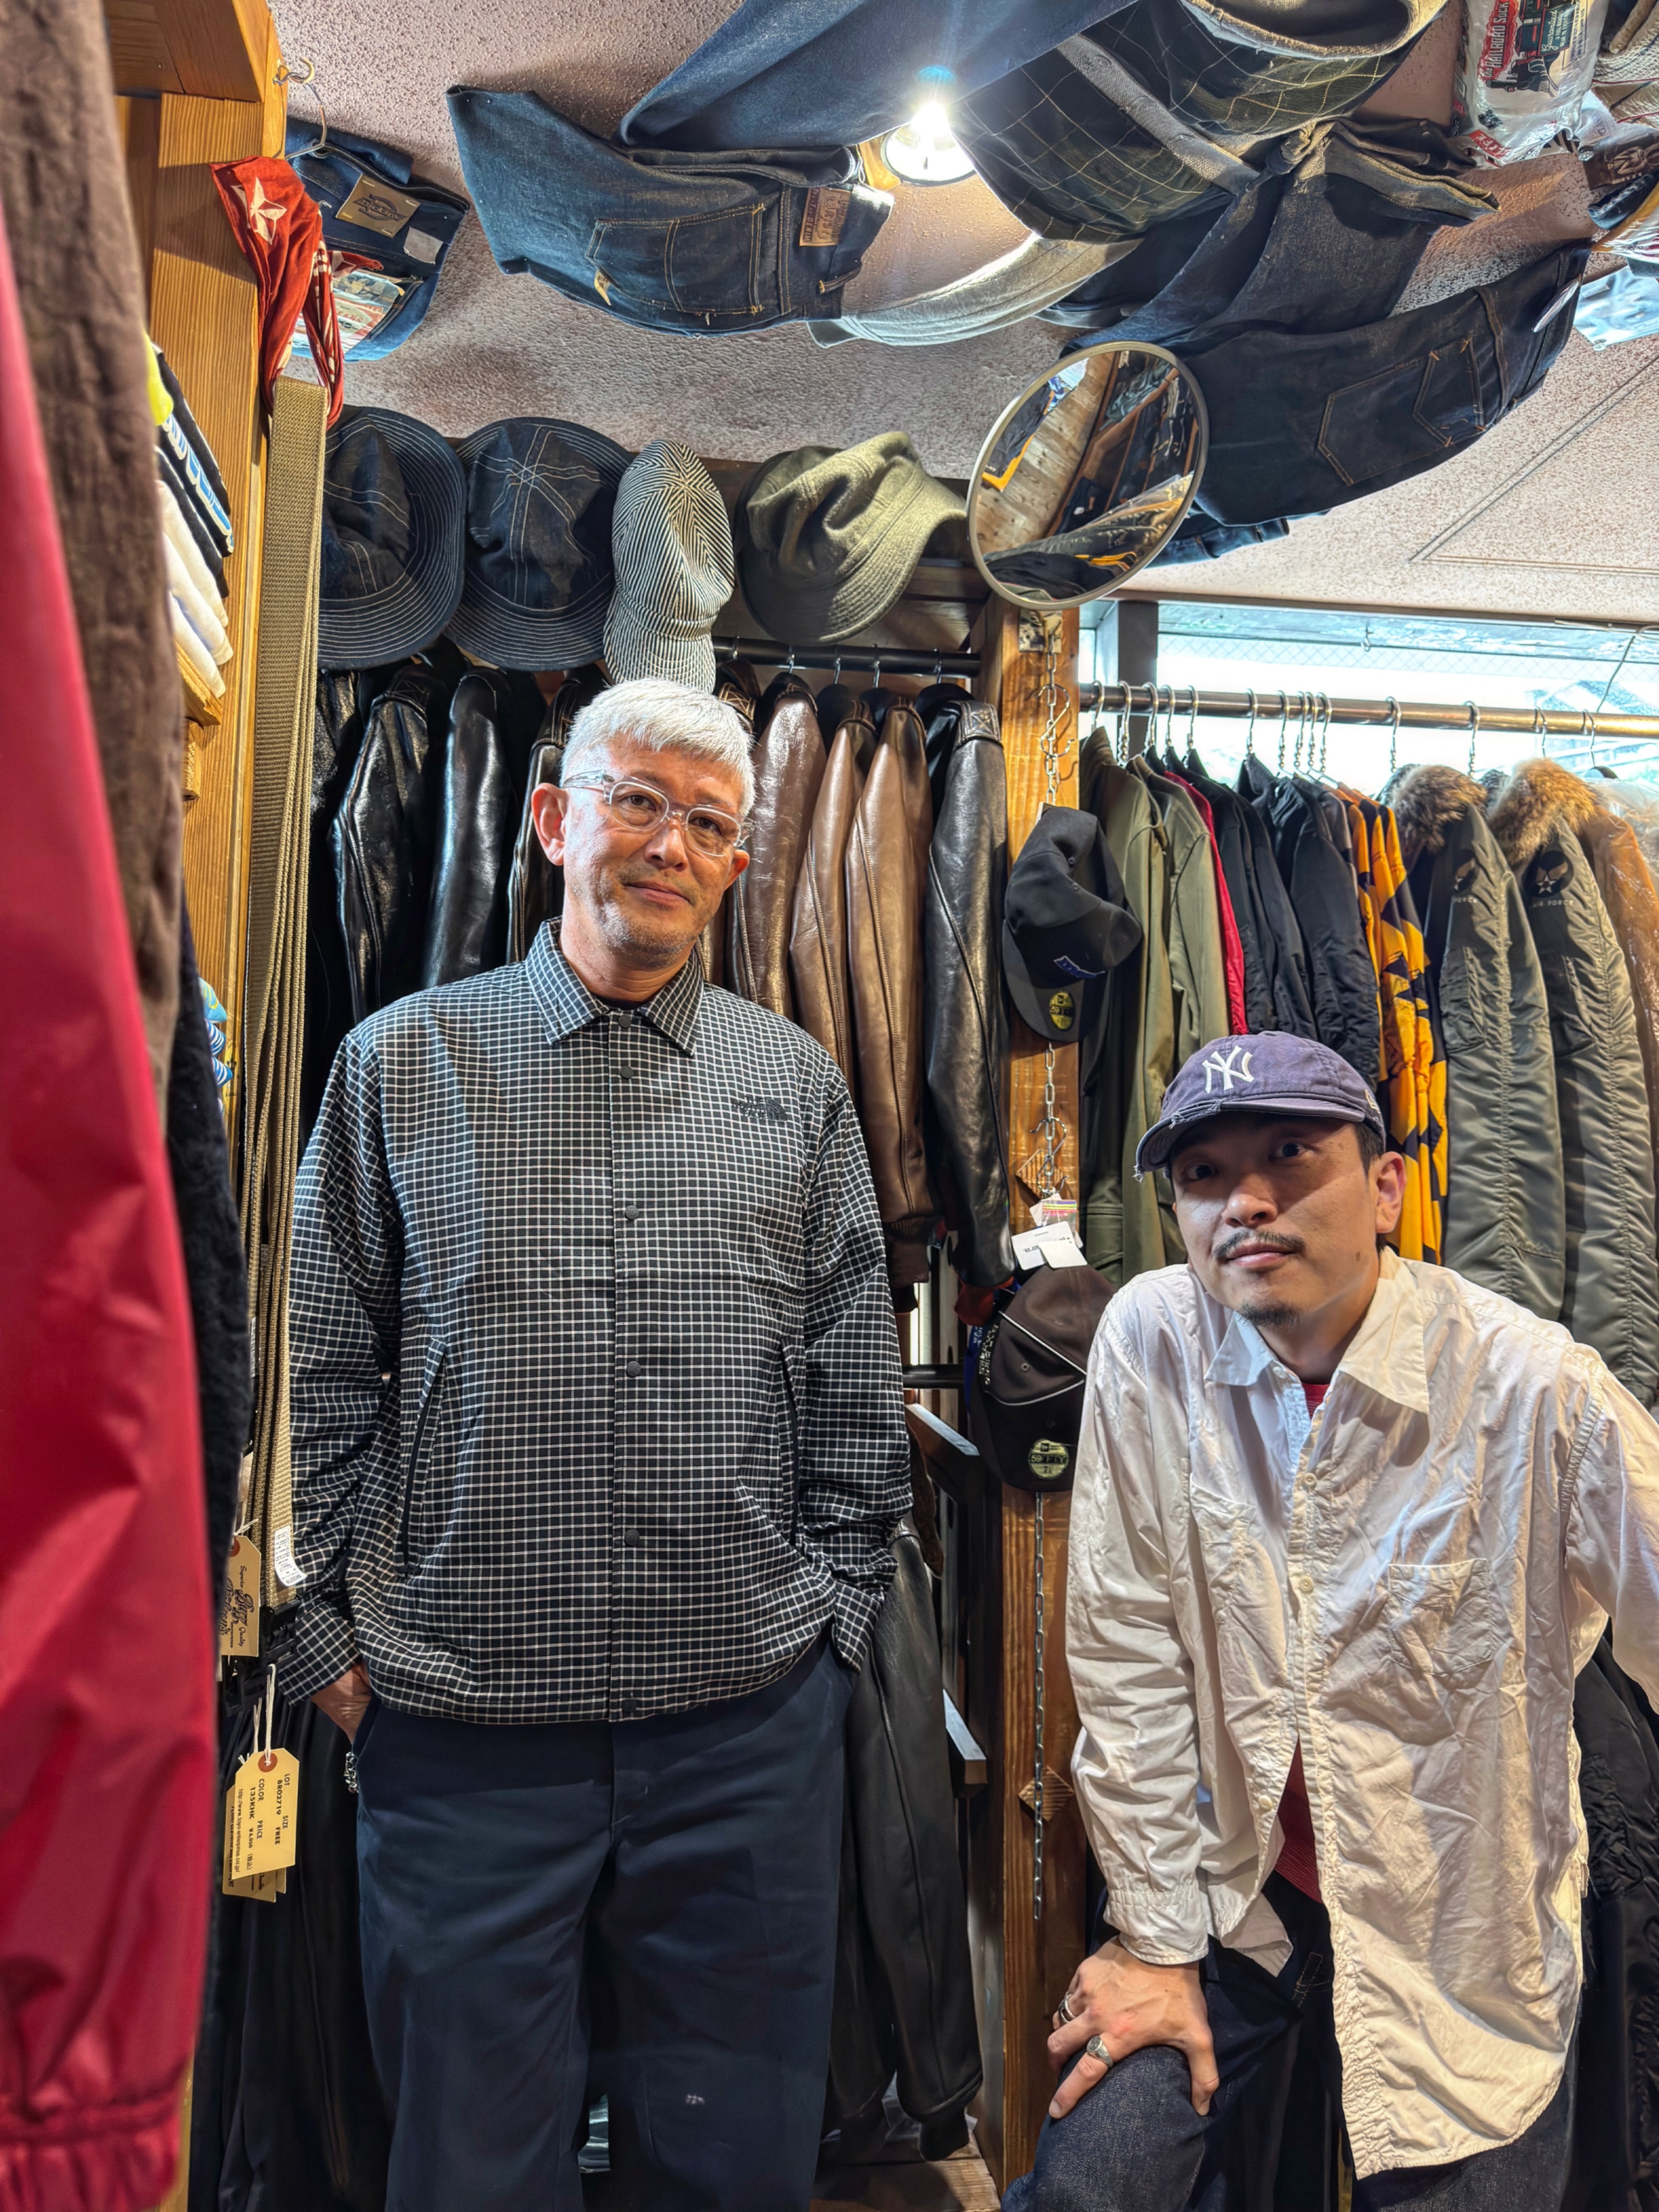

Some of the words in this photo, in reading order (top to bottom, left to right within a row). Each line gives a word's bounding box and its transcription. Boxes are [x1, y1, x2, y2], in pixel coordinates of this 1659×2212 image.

[1485, 25, 1506, 68] RAILROAD
[1541, 10, 1559, 51] Guaranteed
[1202, 1046, 1255, 1094] NY
[231, 1589, 254, 1626] Buzz
[238, 1627, 246, 1647] Quality
